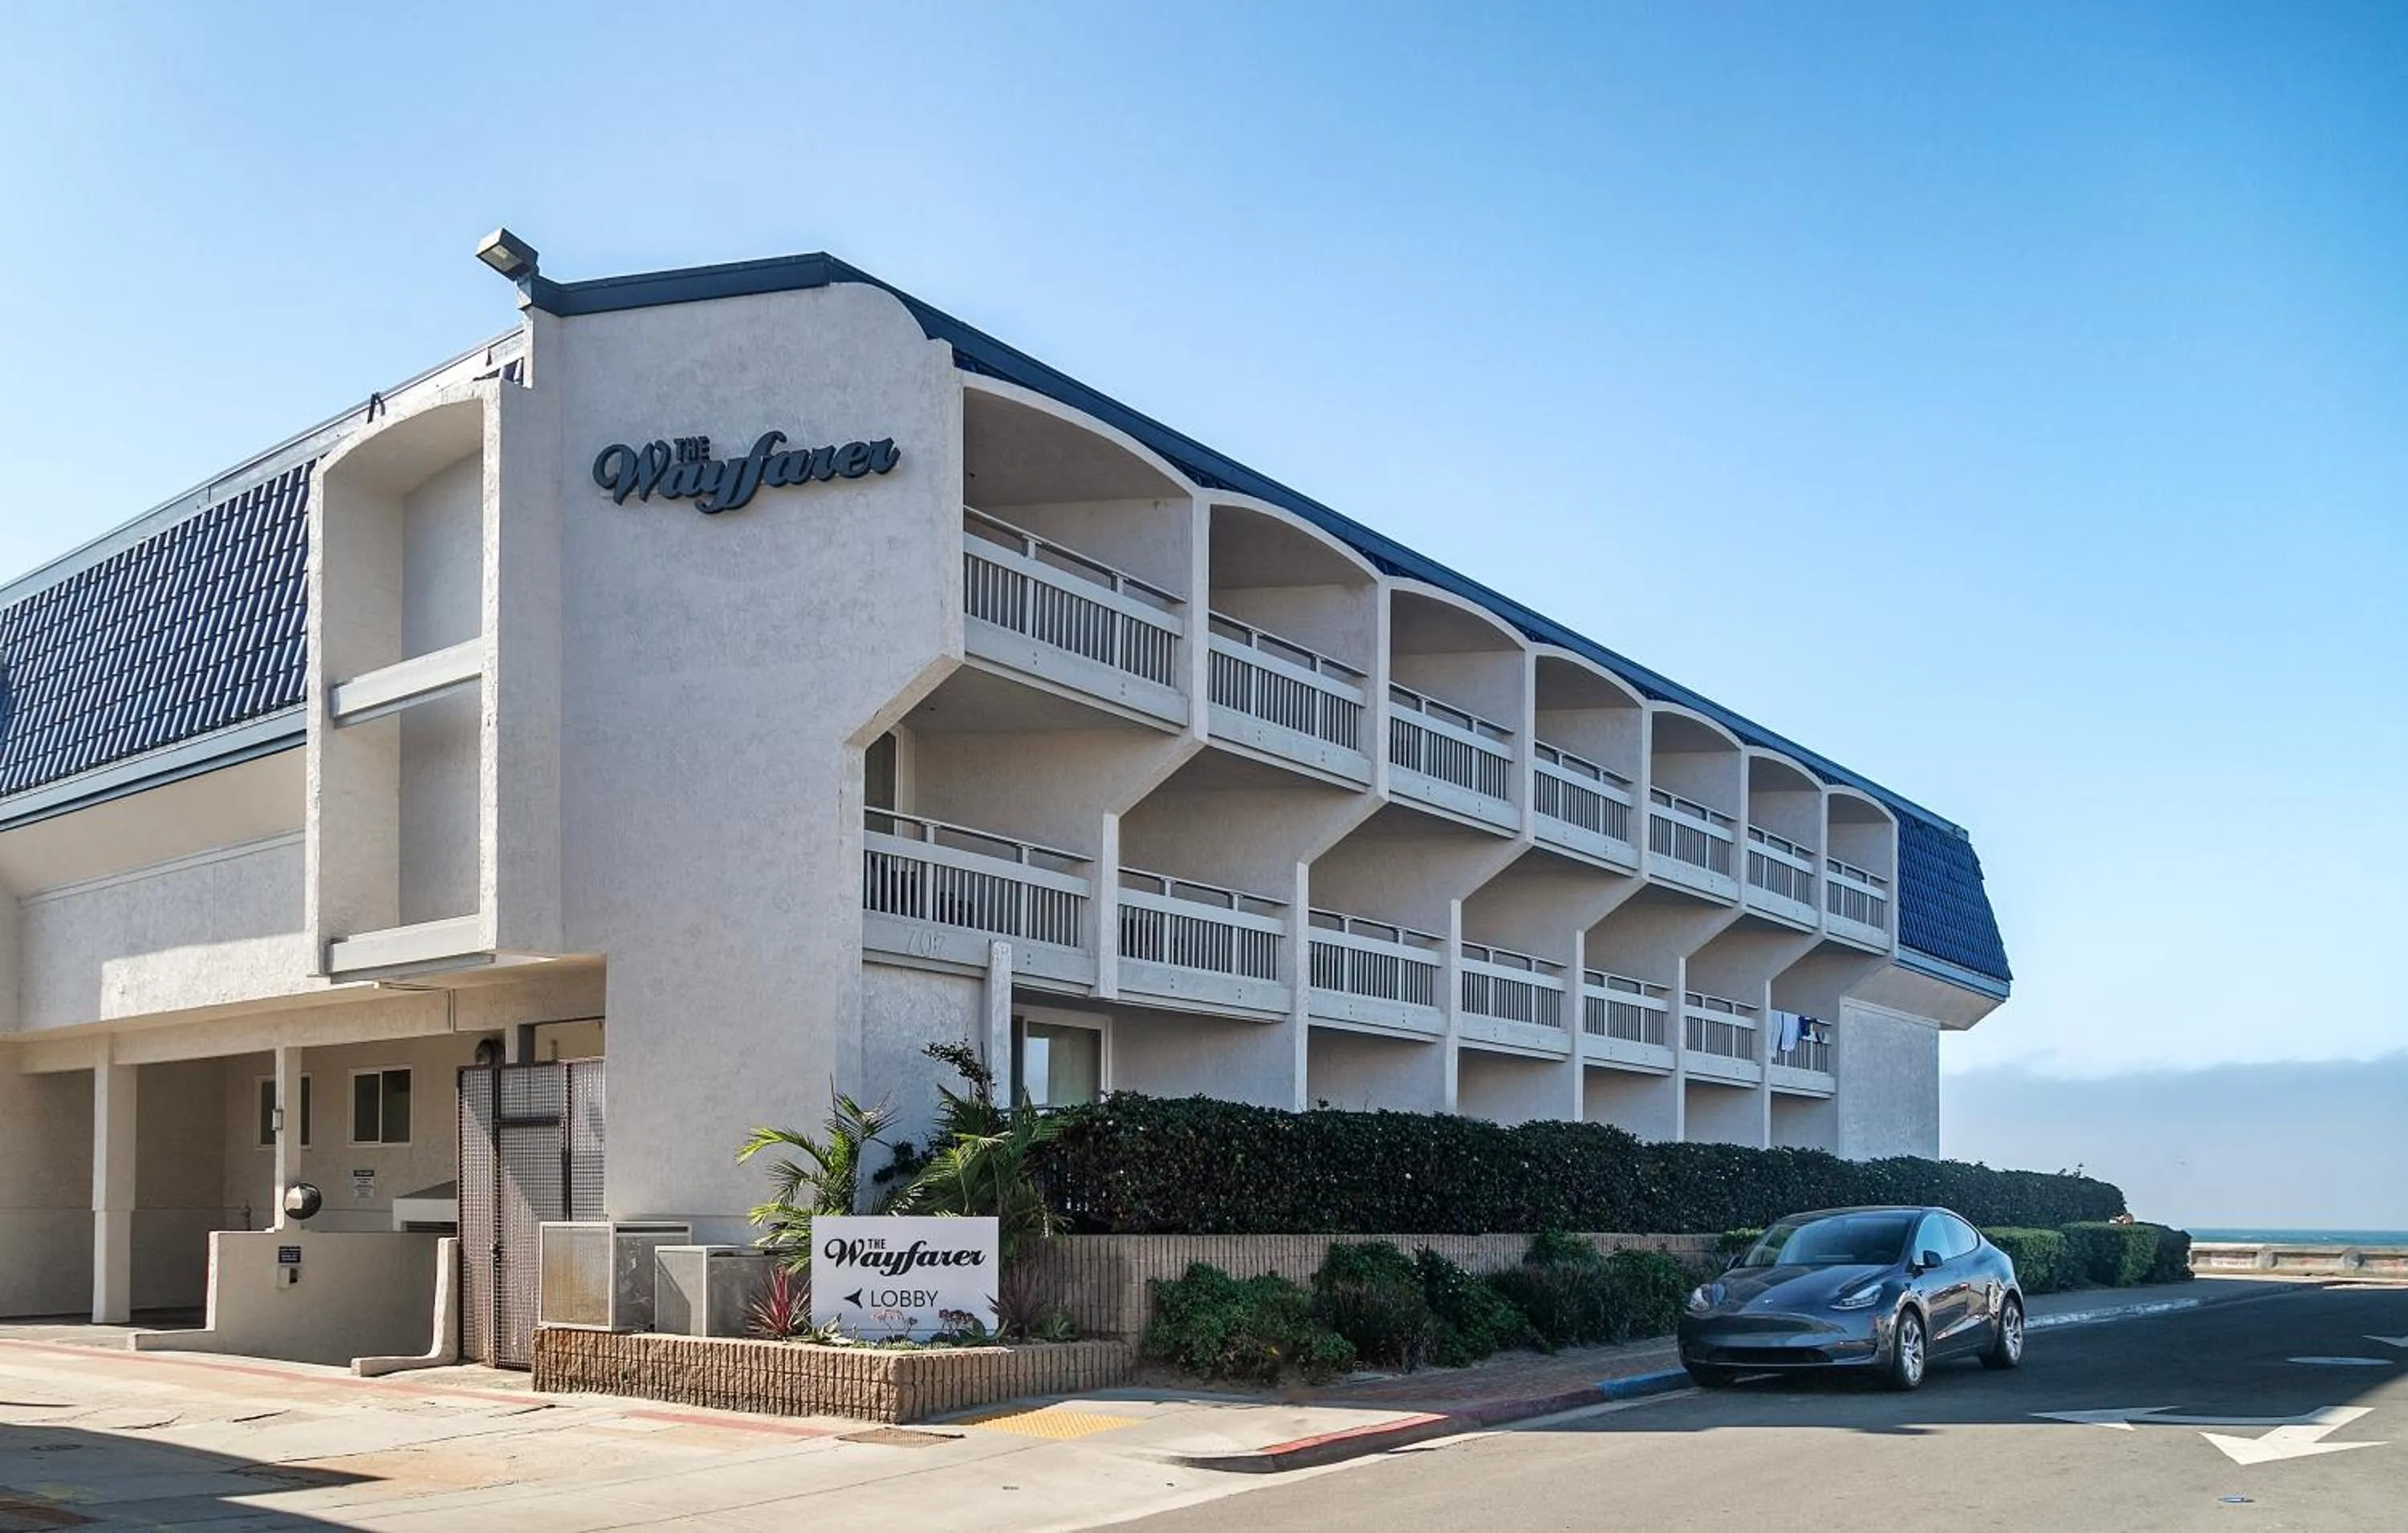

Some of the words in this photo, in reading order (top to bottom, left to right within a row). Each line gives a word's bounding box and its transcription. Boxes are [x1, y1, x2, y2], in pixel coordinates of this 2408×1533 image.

[673, 436, 710, 462] THE
[592, 430, 901, 514] Wayfarer
[867, 1238, 886, 1249] THE
[824, 1238, 986, 1276] Wayfarer
[871, 1290, 938, 1307] LOBBY
